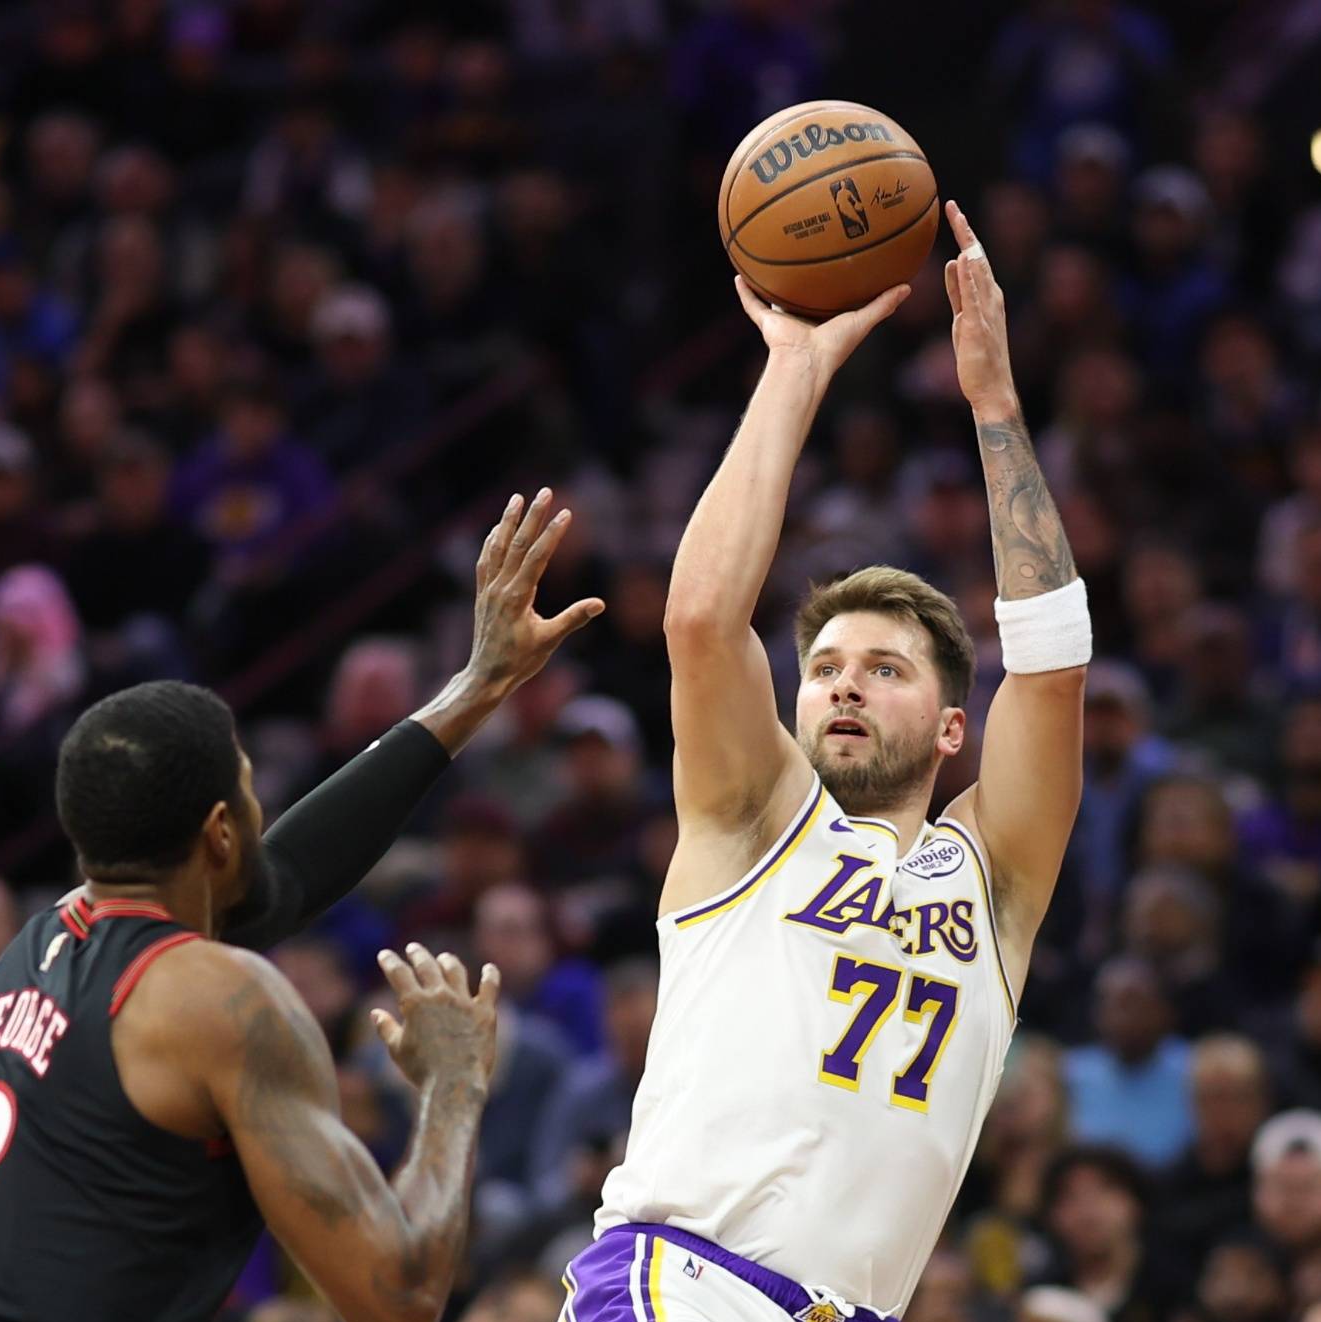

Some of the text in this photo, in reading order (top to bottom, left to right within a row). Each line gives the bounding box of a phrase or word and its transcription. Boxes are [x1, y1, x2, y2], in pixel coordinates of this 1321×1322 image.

[749, 122, 894, 184] Wilson
[906, 845, 959, 869] bibigo
[817, 952, 961, 1115] 77
